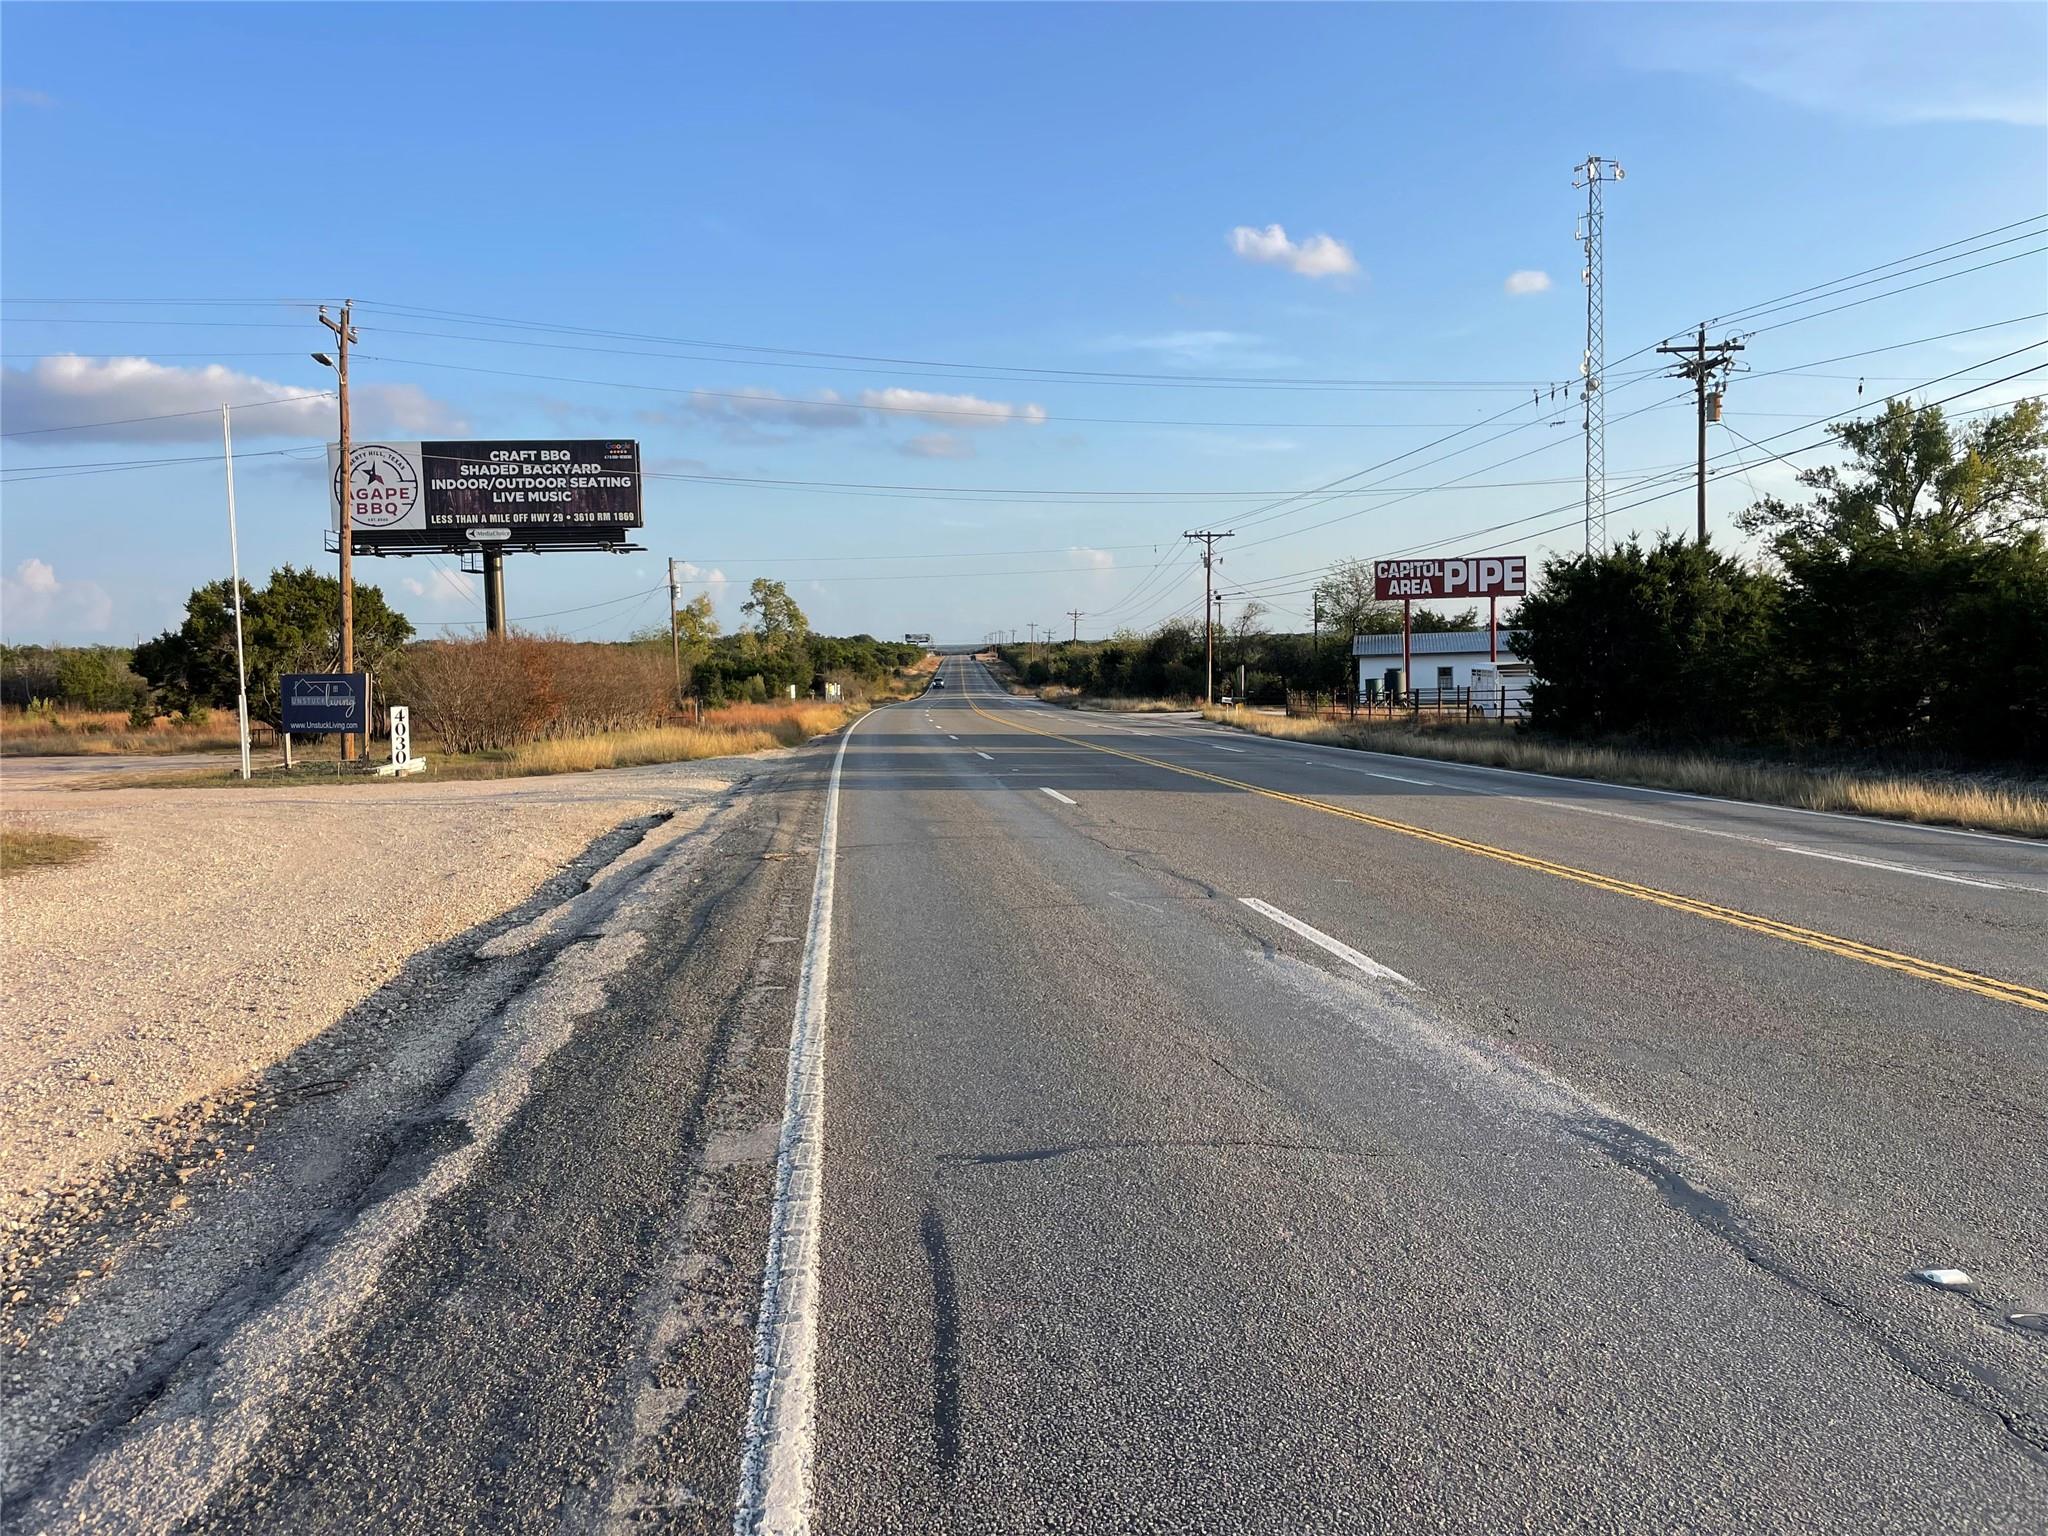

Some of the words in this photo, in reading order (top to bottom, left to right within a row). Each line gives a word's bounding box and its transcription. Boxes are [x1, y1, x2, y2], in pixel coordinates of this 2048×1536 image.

[388, 453, 405, 470] TEXAS
[490, 450, 537, 461] CRAFT
[540, 450, 571, 460] BBQ
[460, 464, 519, 475] SHADED
[522, 463, 601, 475] BACKYARD
[431, 477, 567, 490] INDOOR/OUTDOOR
[569, 476, 631, 488] SEATING
[492, 491, 525, 503] LIVE
[527, 491, 572, 502] MUSIC
[356, 502, 398, 516] BBQ
[431, 514, 453, 524] LESS
[455, 514, 478, 523] THAN
[481, 514, 487, 523] A
[489, 513, 511, 523] MILE
[513, 513, 529, 523] OFF
[530, 513, 550, 522] HWY
[552, 512, 564, 522] 29
[596, 512, 611, 521] RM
[613, 512, 635, 521] 1869
[1377, 561, 1443, 578] CAPITOL
[1443, 558, 1525, 593] PIPE
[1388, 579, 1433, 595] AREA
[291, 697, 326, 705] UNSTUCK
[290, 721, 358, 730] www.UnstuckLiving.com
[394, 708, 407, 765] 4030
